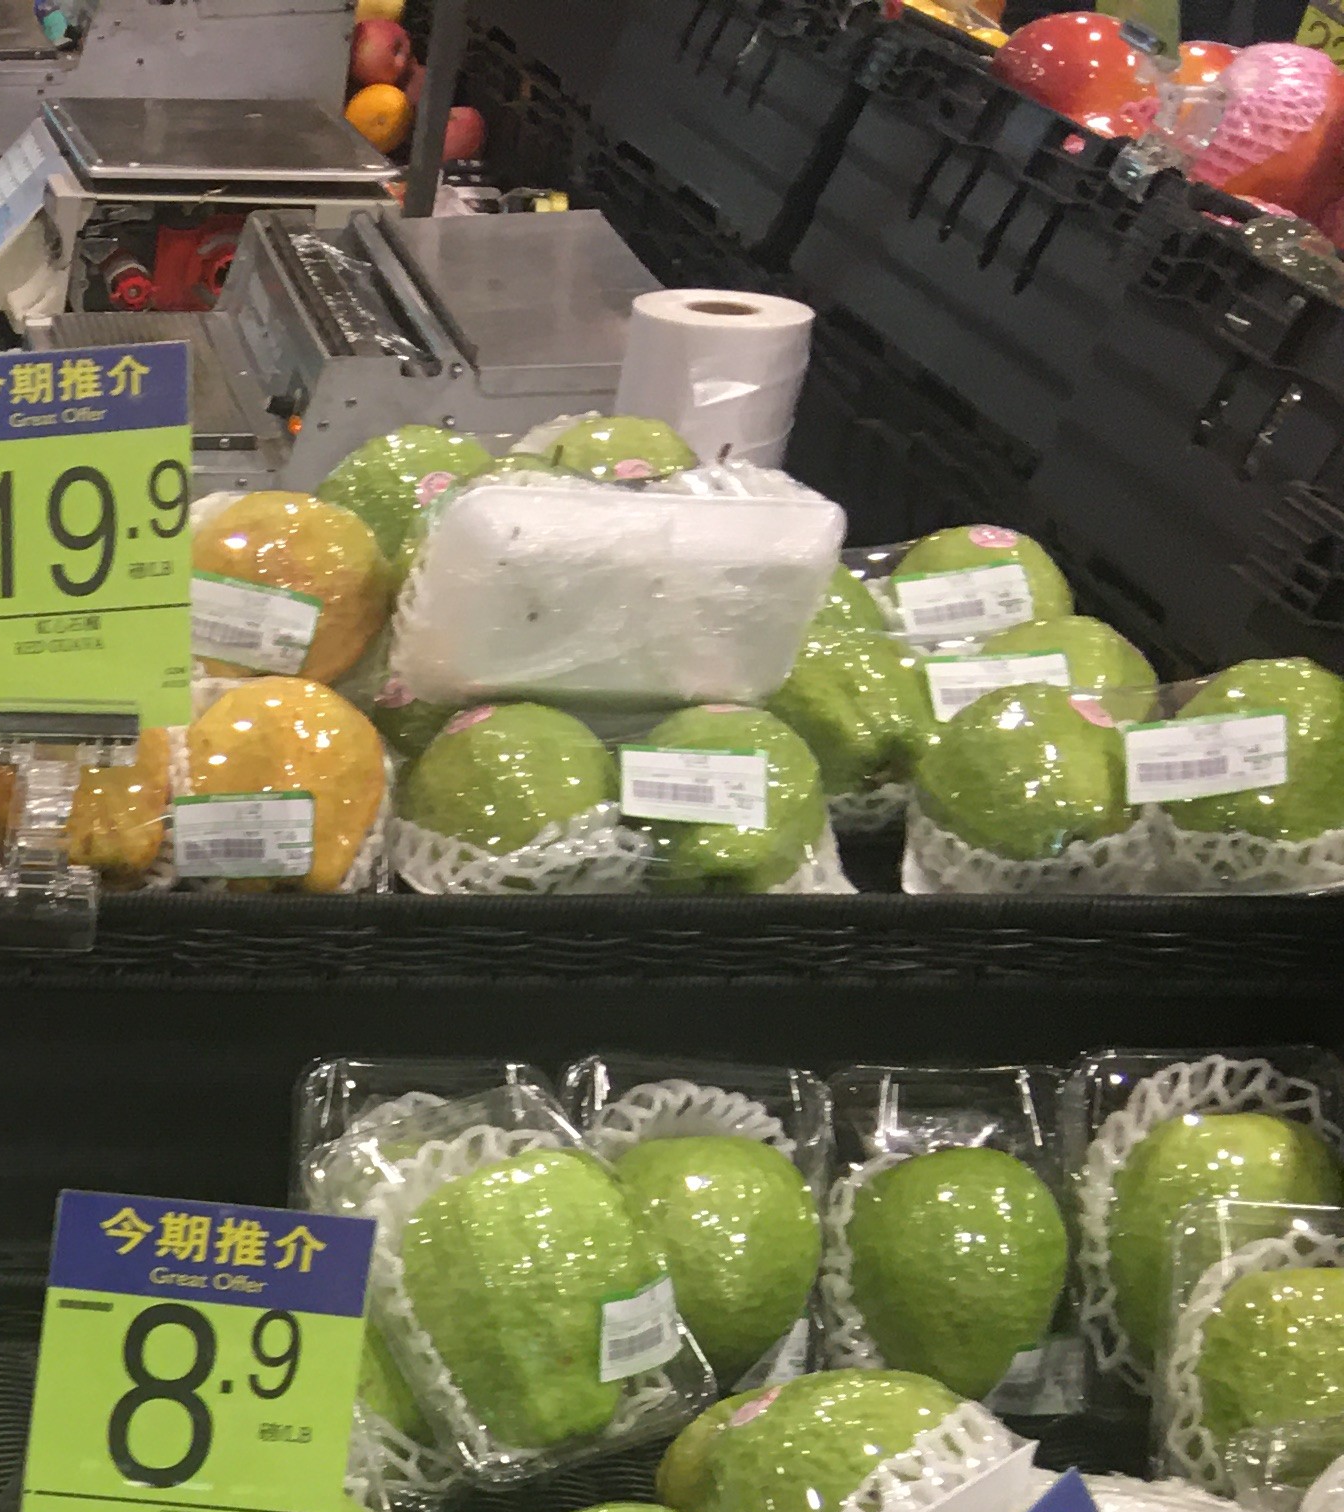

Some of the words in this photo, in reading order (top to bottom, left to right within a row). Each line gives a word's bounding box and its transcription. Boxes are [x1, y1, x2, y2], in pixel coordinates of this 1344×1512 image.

[9, 408, 58, 428] Great
[61, 406, 108, 424] Offer
[100, 1207, 328, 1273] 今期推介
[149, 1268, 208, 1290] Great
[212, 1272, 268, 1294] Offer
[107, 1303, 301, 1489] 8.9
